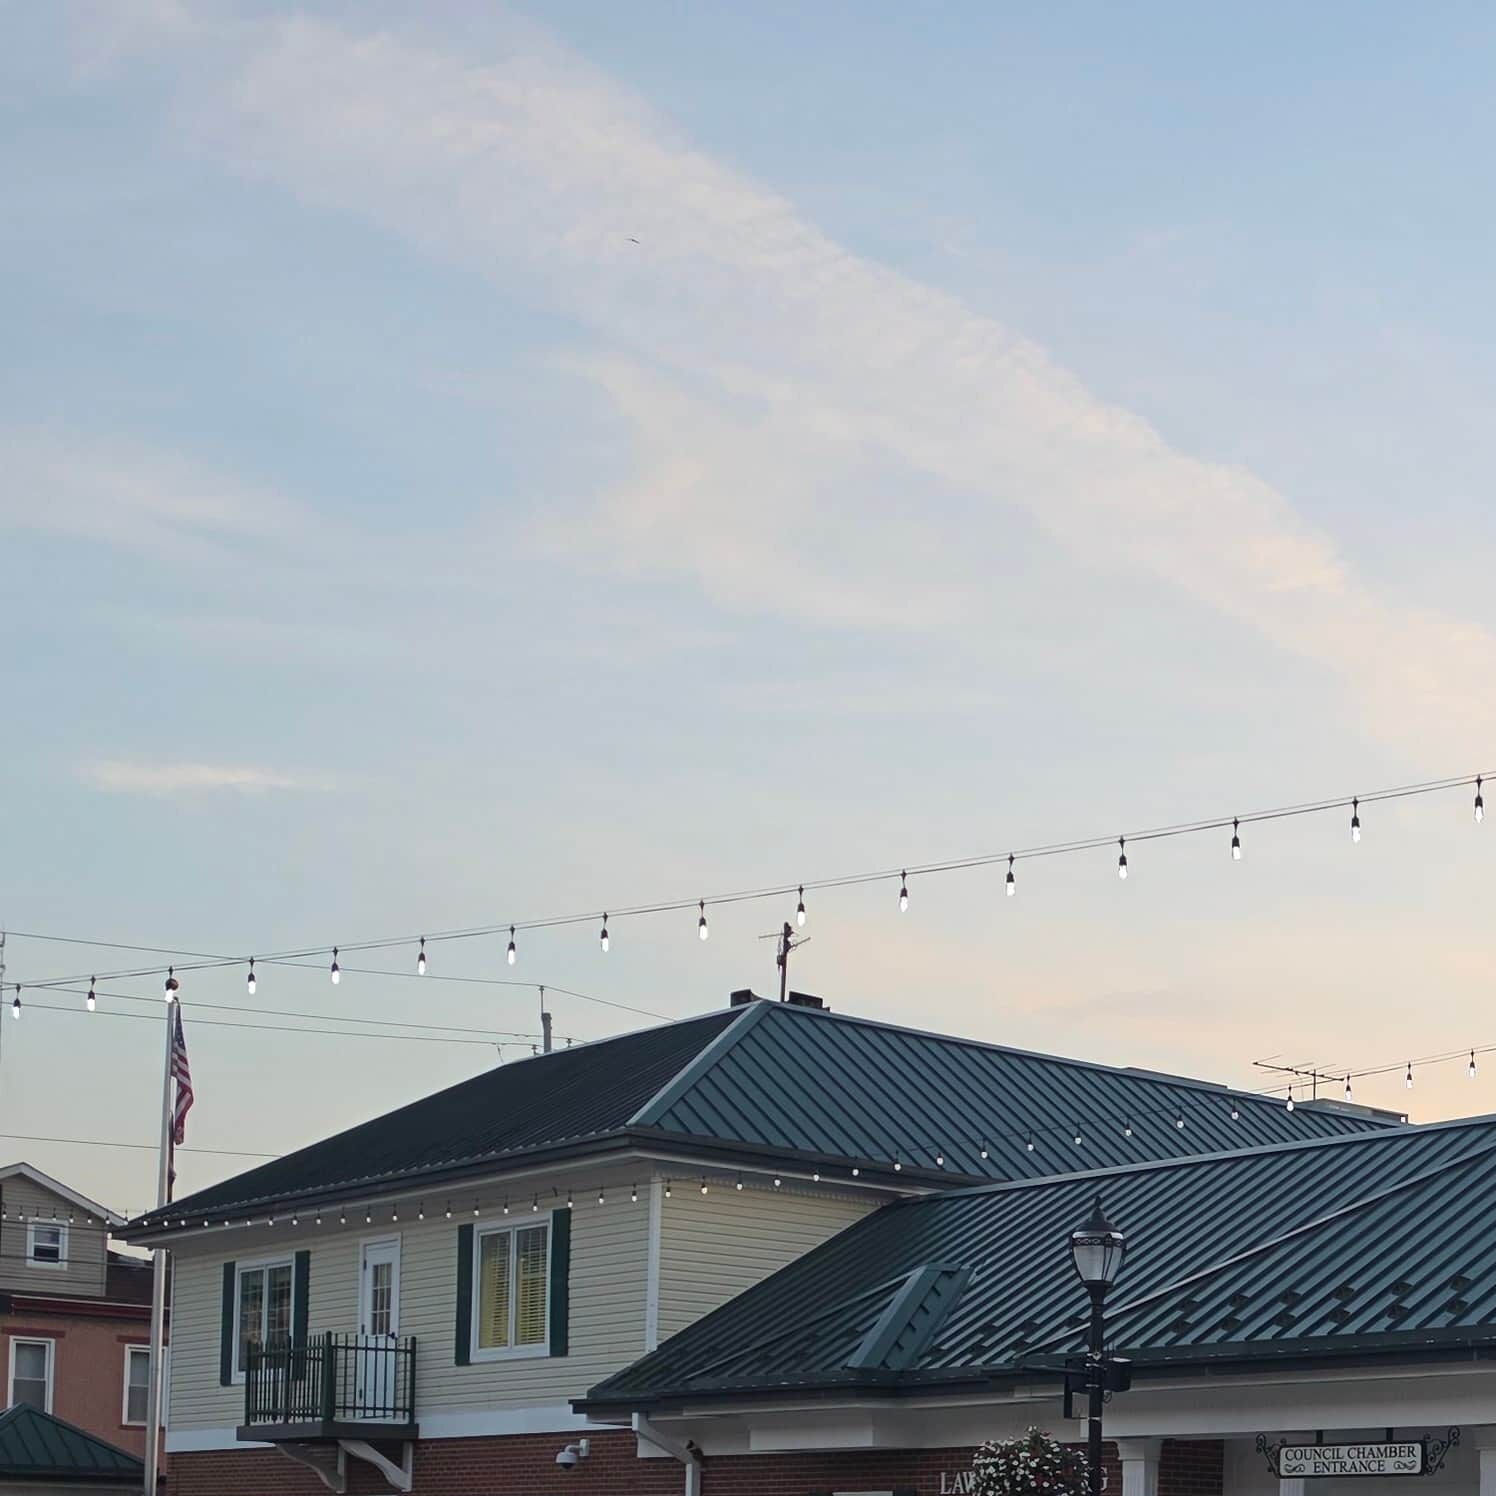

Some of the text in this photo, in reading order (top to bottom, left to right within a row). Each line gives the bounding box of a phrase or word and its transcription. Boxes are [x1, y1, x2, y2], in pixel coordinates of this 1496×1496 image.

[1284, 1445, 1416, 1461] COUNCIL CHAMBER
[1313, 1460, 1386, 1473] ENTRANCE
